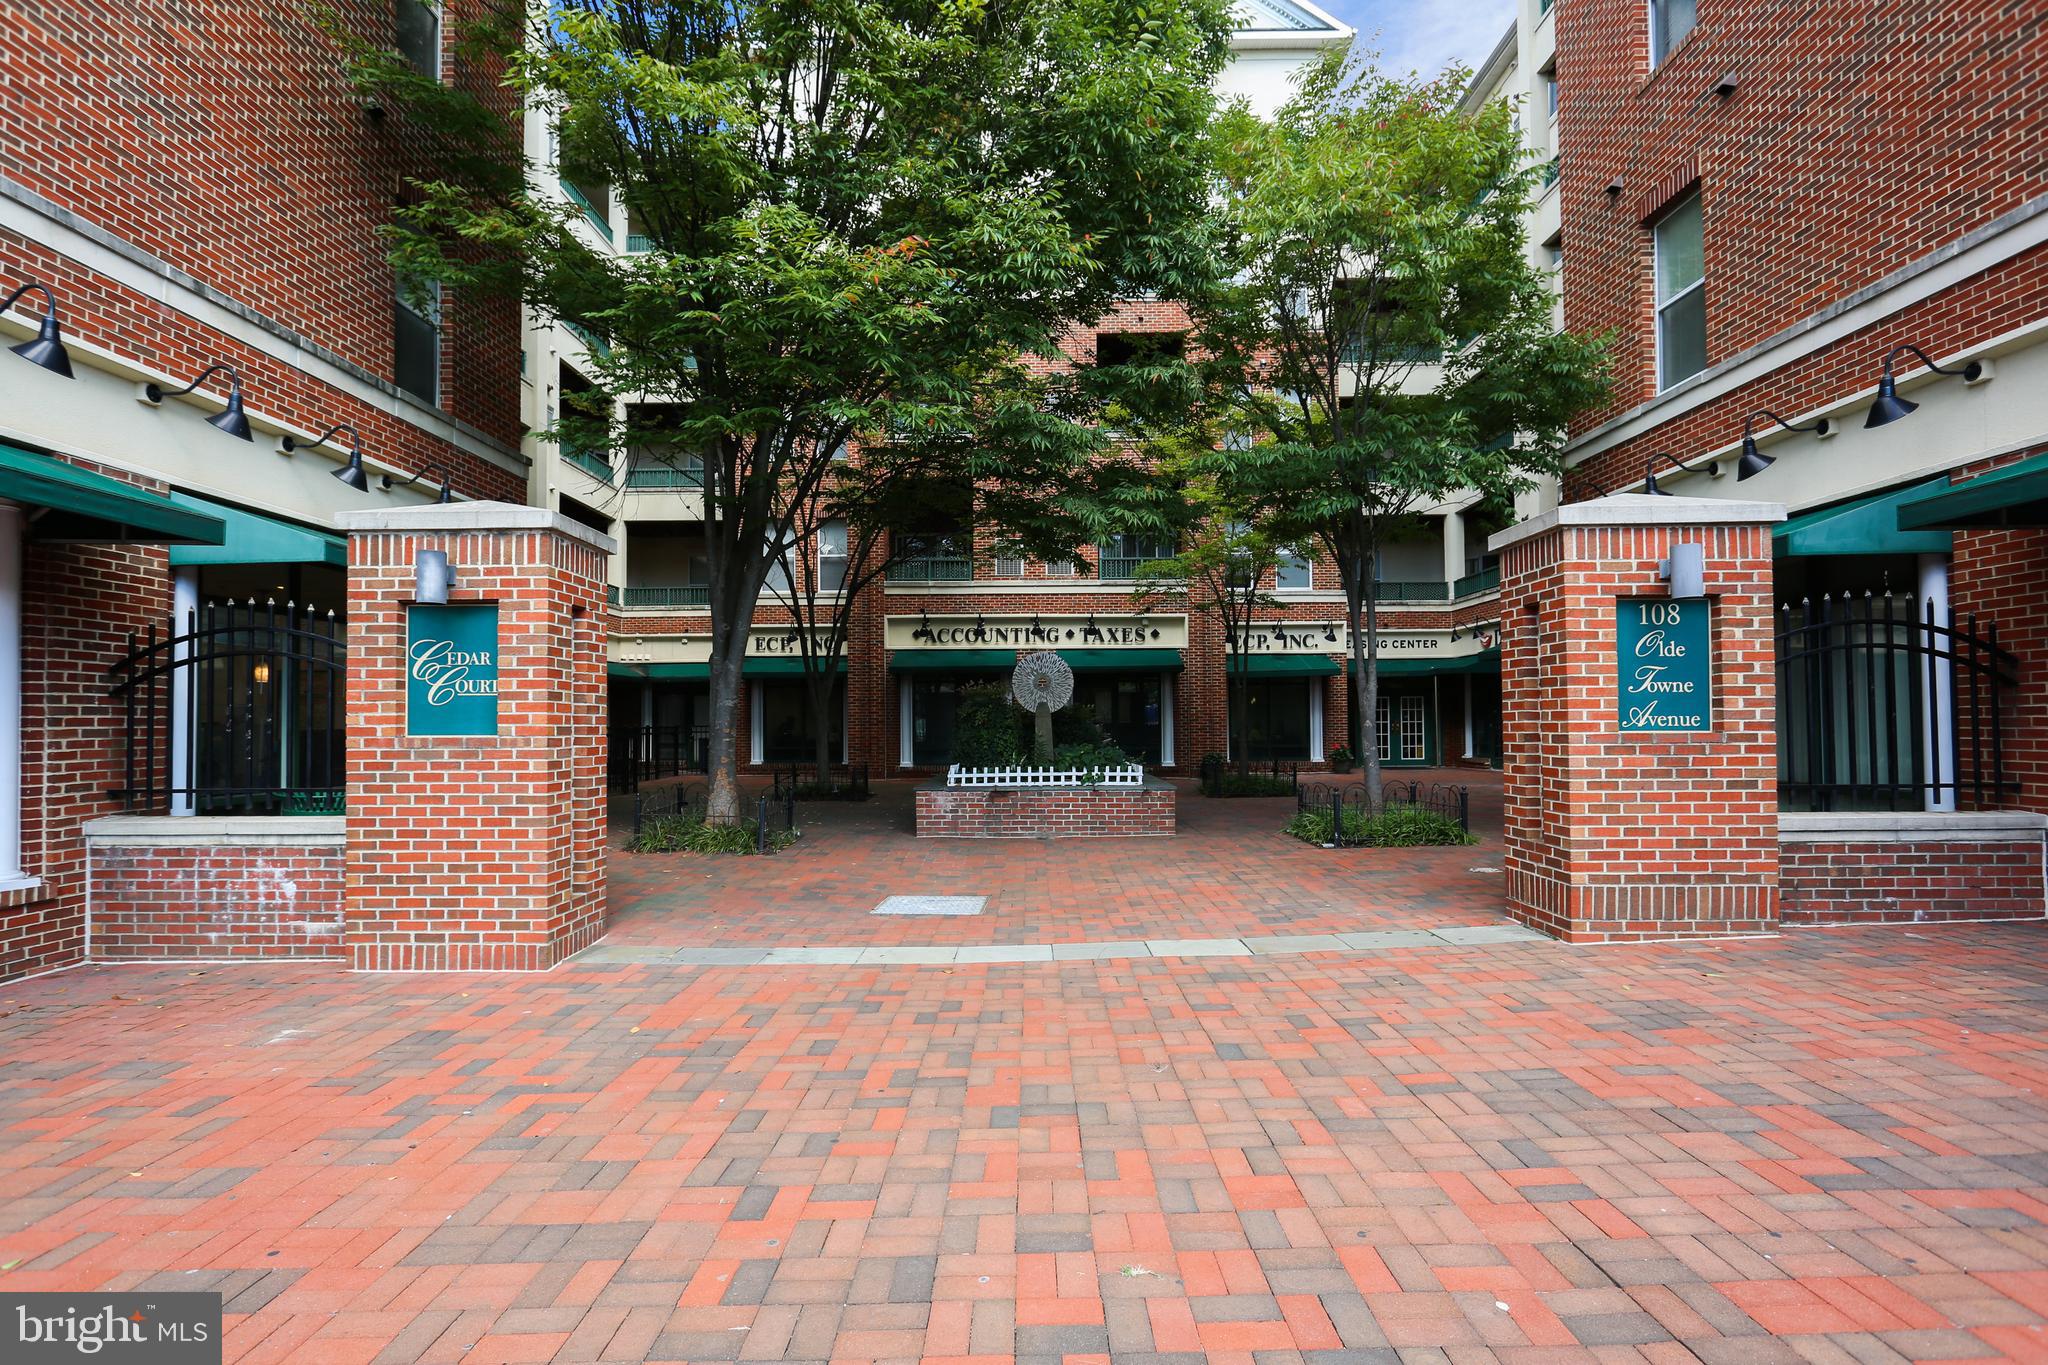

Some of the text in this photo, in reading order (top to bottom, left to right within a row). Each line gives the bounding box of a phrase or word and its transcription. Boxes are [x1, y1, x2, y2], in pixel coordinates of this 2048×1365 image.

[1639, 603, 1681, 625] 108
[924, 627, 1146, 644] ACCOUNTING TAXES
[1281, 633, 1318, 649] INC.
[1392, 639, 1438, 649] CENTER
[1635, 629, 1686, 657] Olde
[410, 639, 492, 680] CEDAR
[1628, 665, 1694, 693] Towne
[1622, 700, 1701, 728] Avenue
